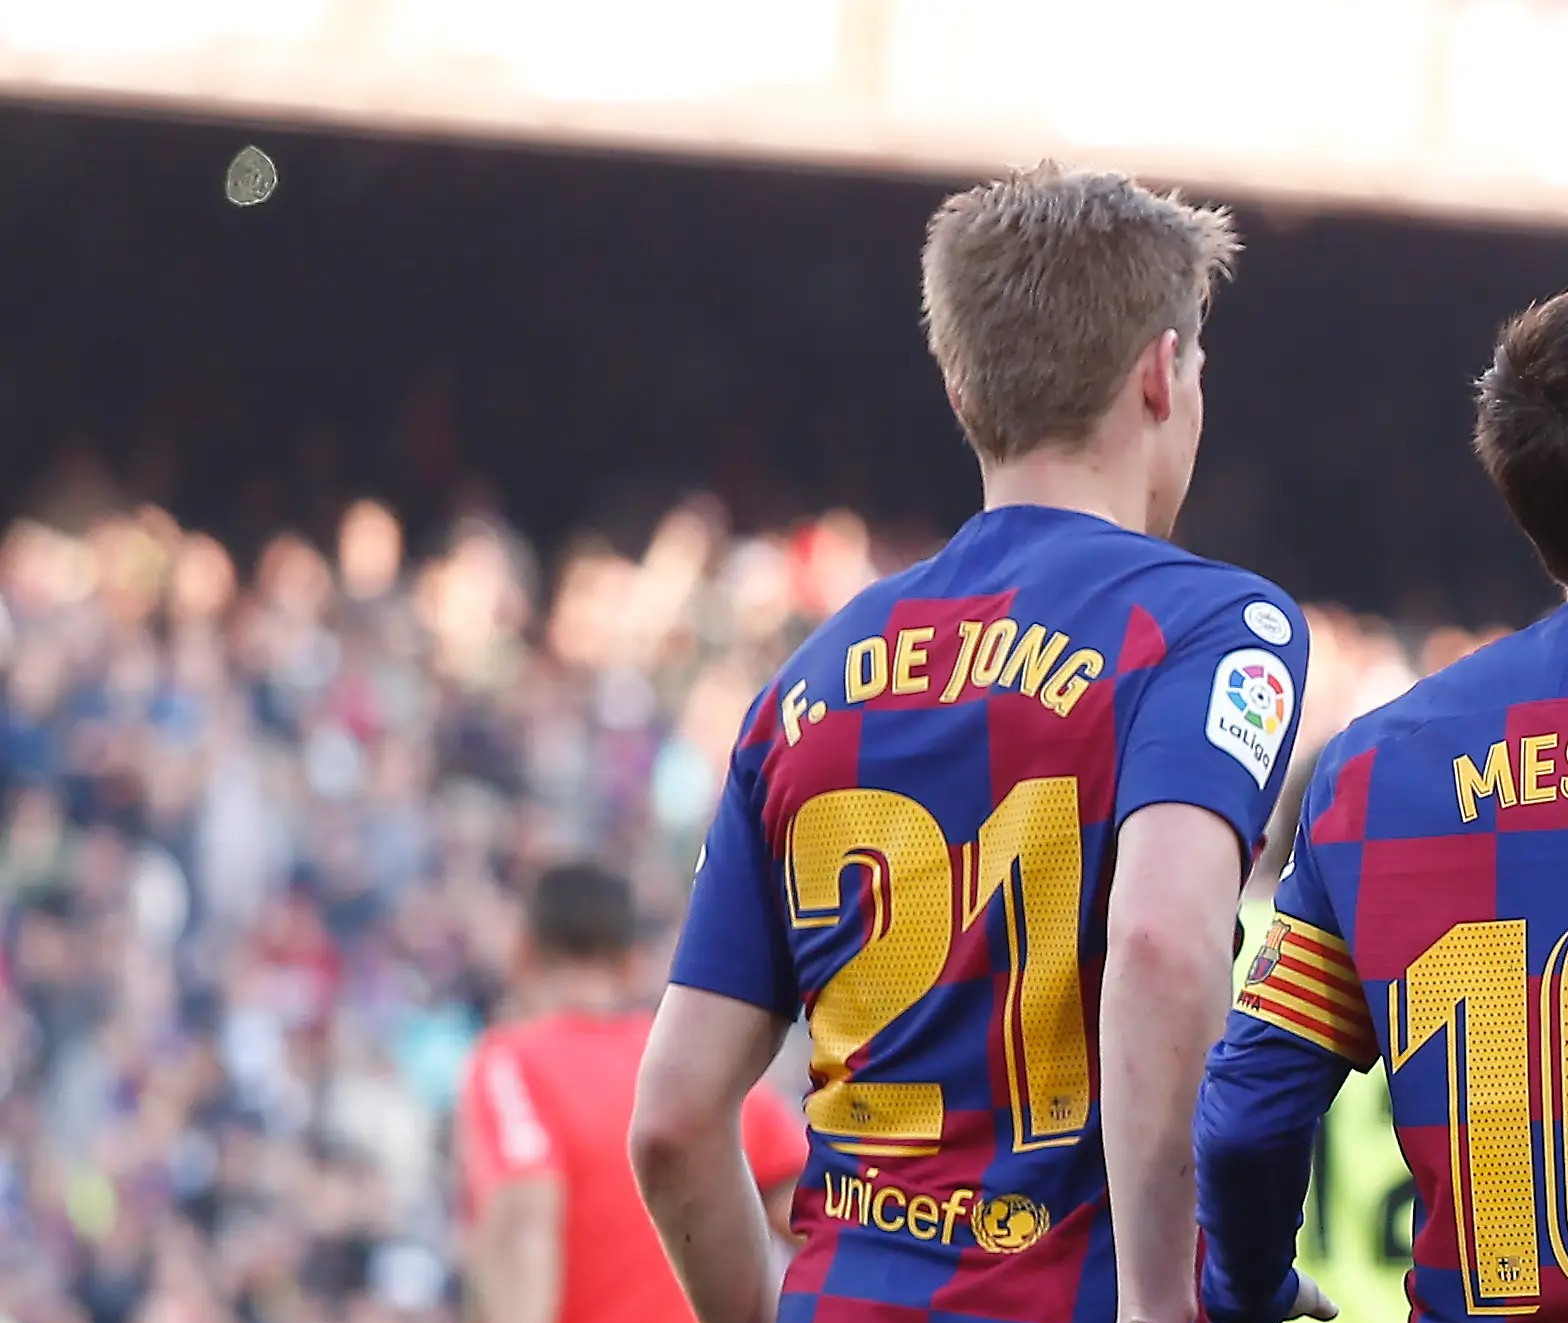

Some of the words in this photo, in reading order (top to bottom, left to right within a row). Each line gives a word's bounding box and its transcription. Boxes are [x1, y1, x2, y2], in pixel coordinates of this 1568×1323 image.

[781, 678, 828, 748] F.
[844, 626, 935, 703] DE
[939, 618, 1104, 718] JONG
[784, 776, 1091, 1157] 21
[824, 1167, 973, 1245] unicef
